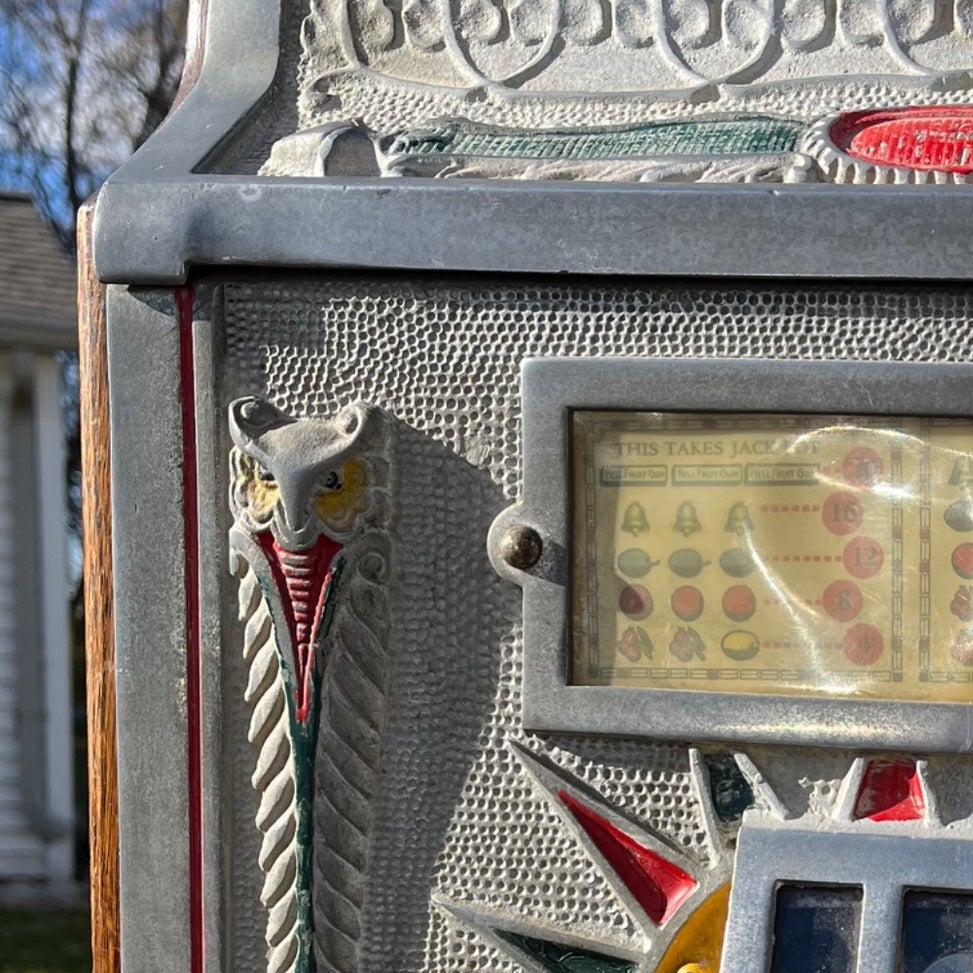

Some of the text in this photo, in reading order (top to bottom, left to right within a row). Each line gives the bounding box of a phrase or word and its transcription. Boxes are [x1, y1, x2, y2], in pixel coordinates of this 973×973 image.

[613, 441, 659, 456] THIS
[663, 441, 723, 456] TAKES
[831, 501, 858, 523] 16
[853, 545, 878, 567] 12
[837, 589, 852, 611] 8
[857, 634, 872, 655] 4
